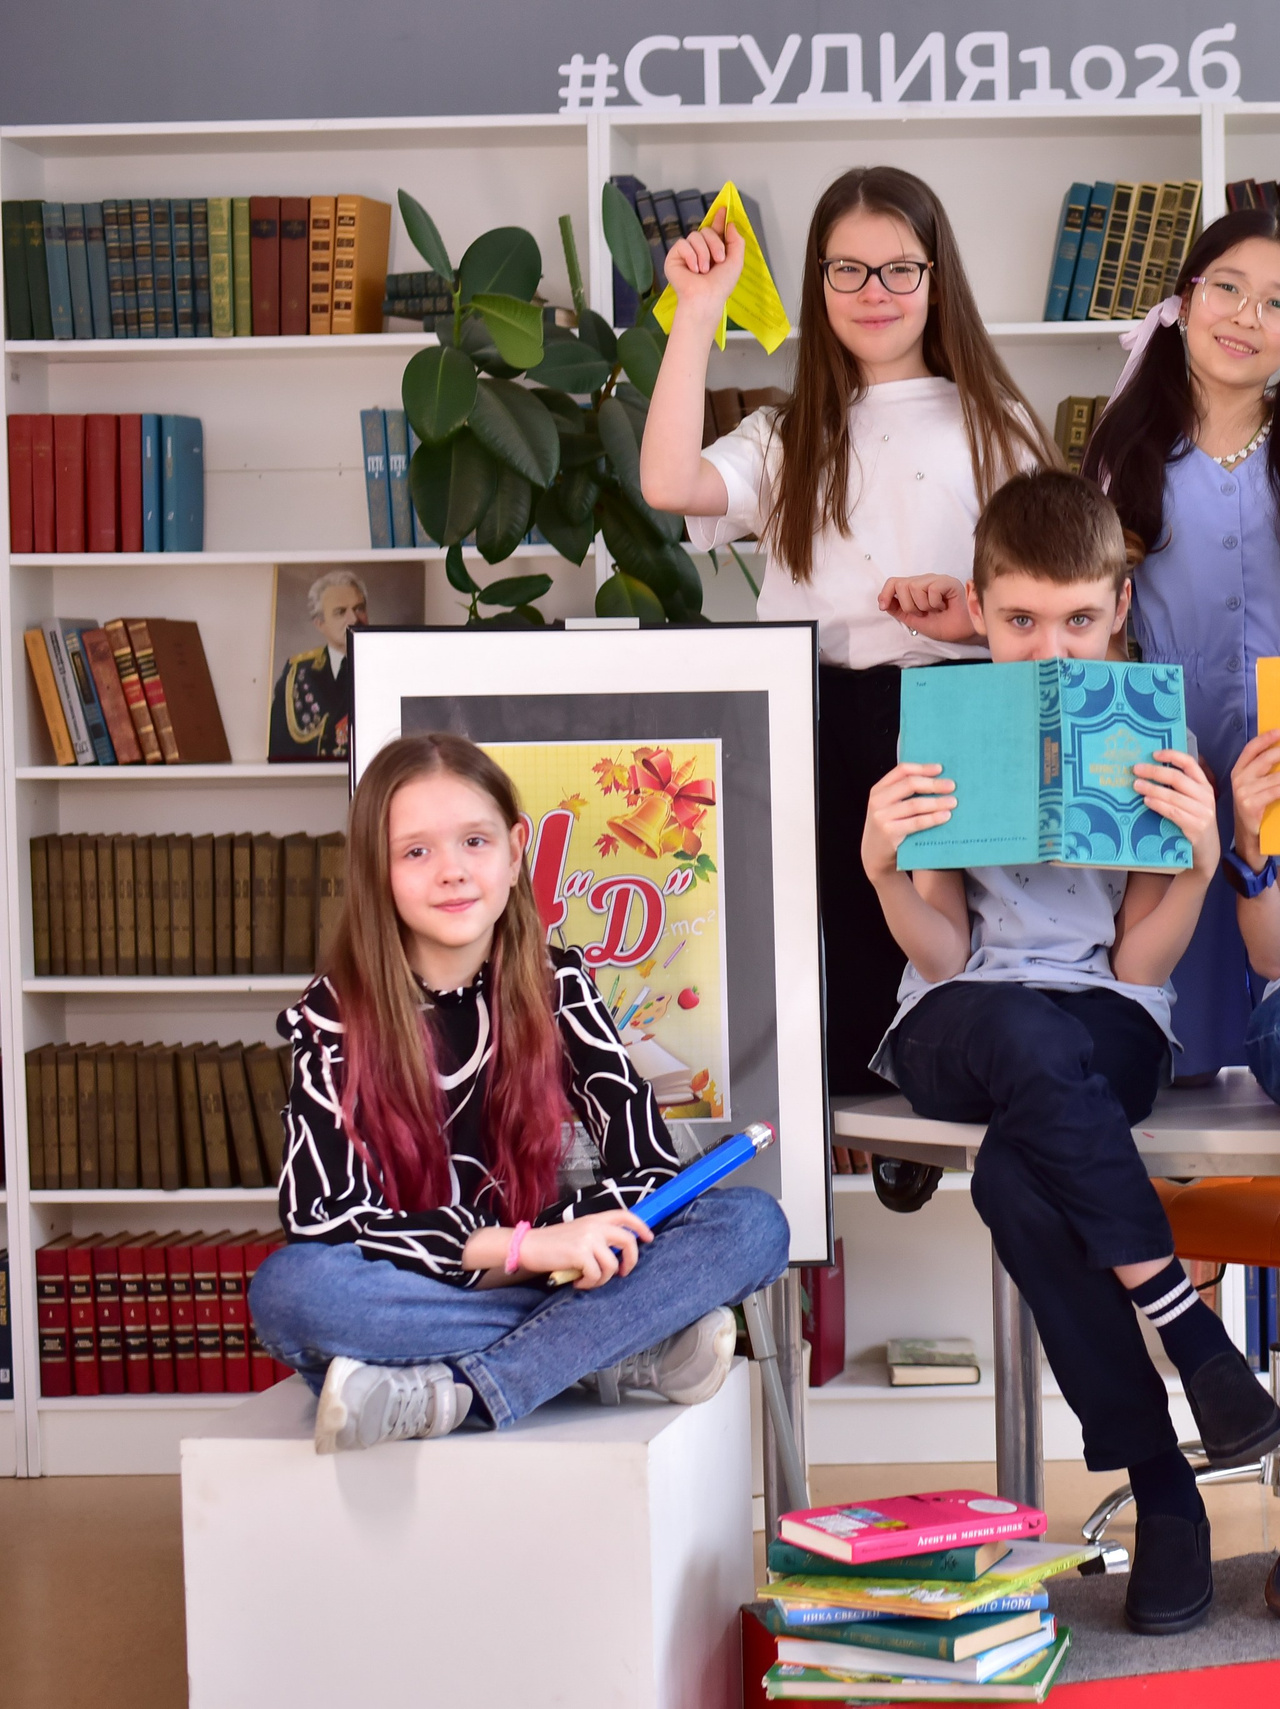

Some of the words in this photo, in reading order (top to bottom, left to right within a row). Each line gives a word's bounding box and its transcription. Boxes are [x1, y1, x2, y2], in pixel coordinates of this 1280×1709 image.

[917, 1535, 944, 1547] Агент
[945, 1533, 957, 1542] на
[961, 1528, 995, 1539] мягких
[996, 1522, 1023, 1534] лапах
[1001, 1597, 1032, 1610] МОРЯ
